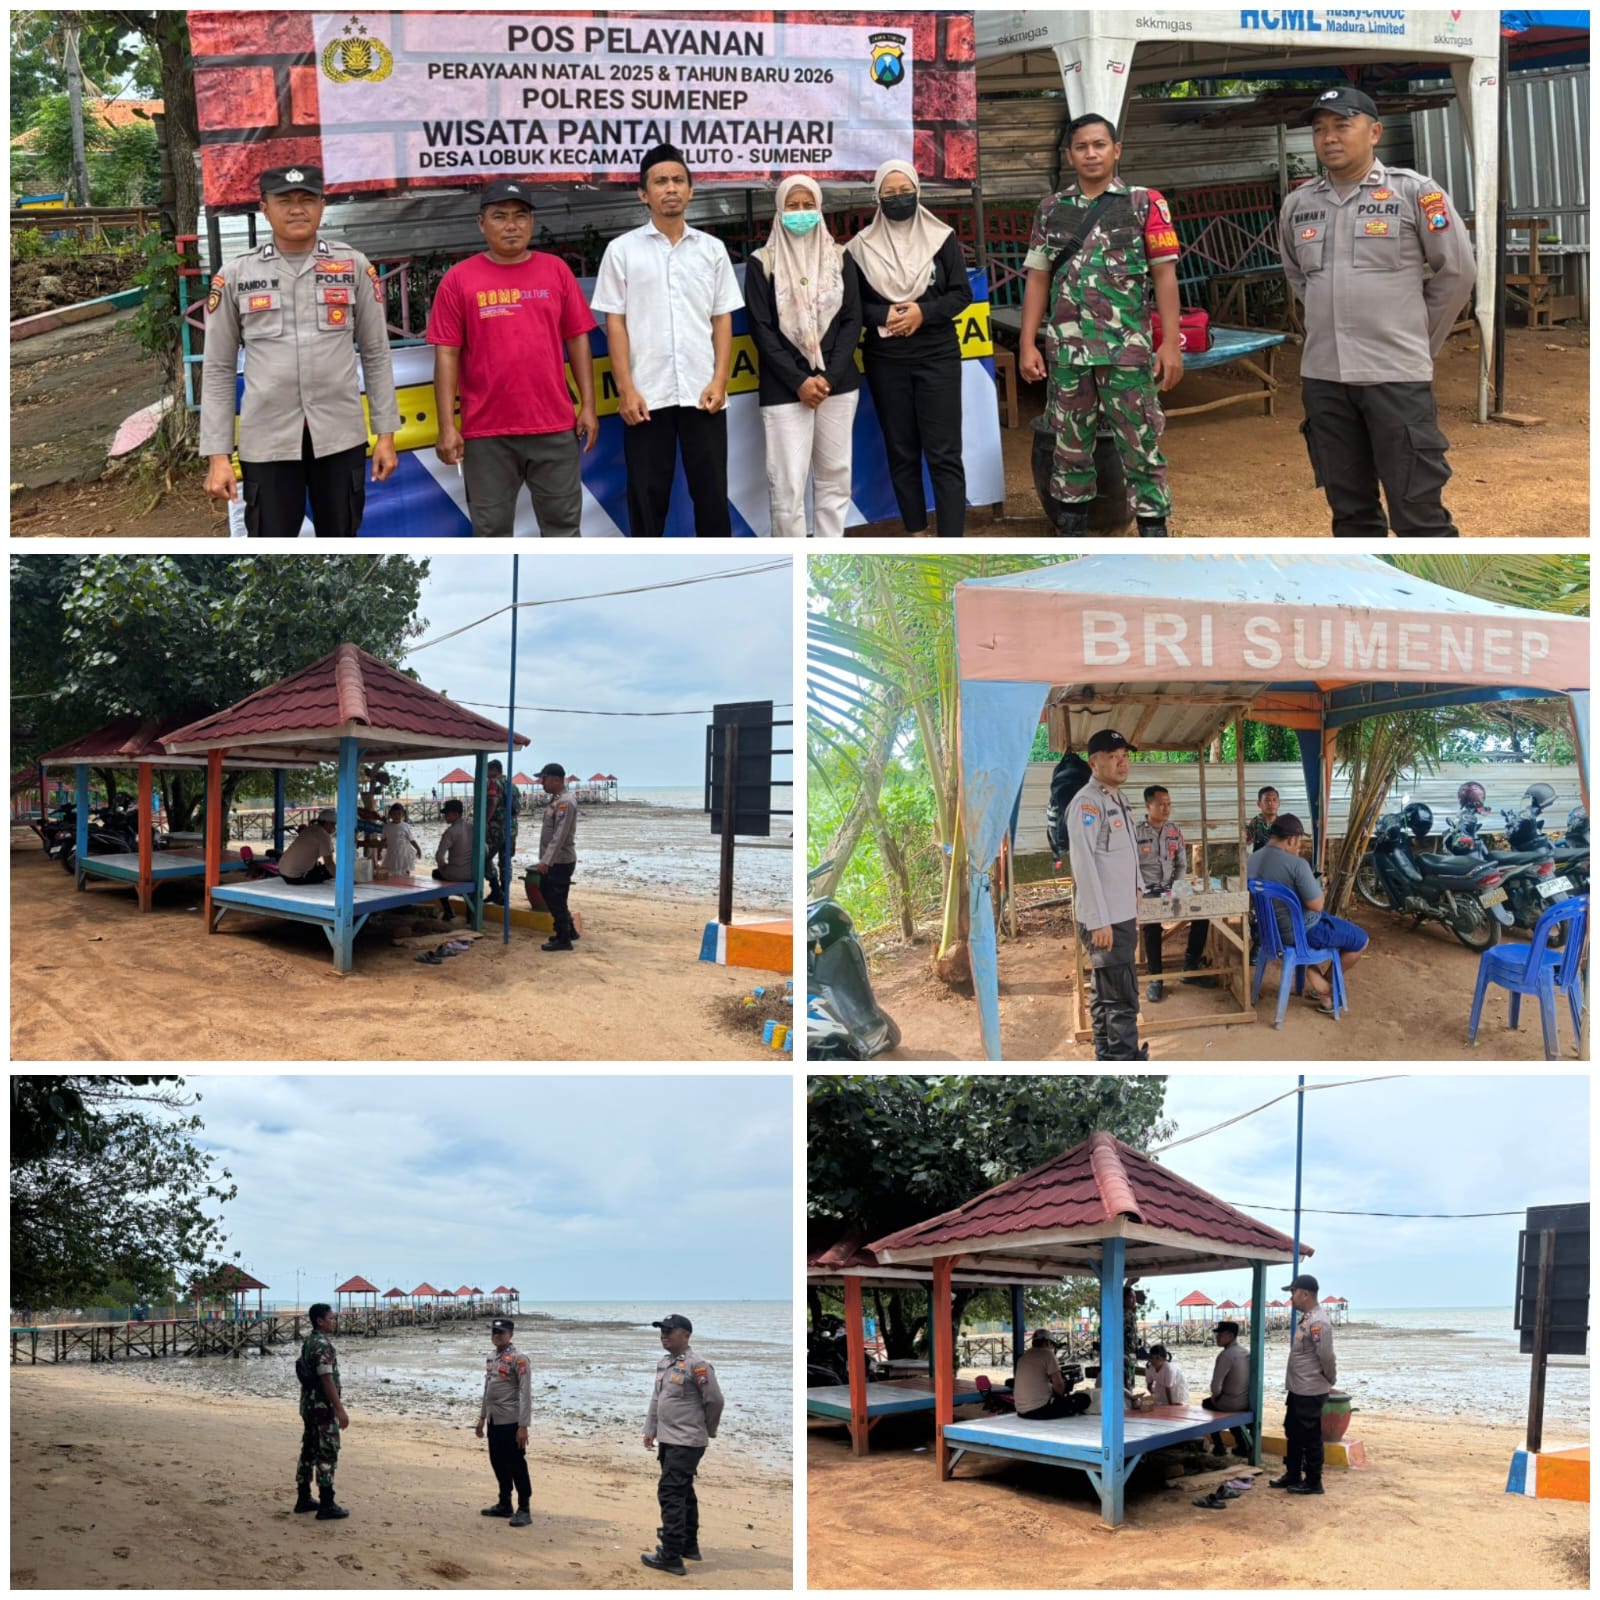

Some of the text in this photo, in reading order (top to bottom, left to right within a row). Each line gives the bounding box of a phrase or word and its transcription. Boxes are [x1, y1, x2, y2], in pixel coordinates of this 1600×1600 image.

[1136, 17, 1192, 32] skkmigas
[1326, 20, 1405, 35] Madura Limited
[507, 25, 764, 56] POS PELAYANAN
[998, 26, 1048, 46] skkmigas
[1433, 35, 1473, 46] skkmigas
[428, 63, 834, 84] PERAYAAN NATAL 2025 & TAHUN BARU 2026
[522, 88, 748, 111] POLRES SUMENEP
[422, 120, 834, 147] WISATA PANTAI MATAHARI
[419, 151, 474, 168] DESA
[479, 149, 544, 166] LOBUK
[749, 149, 832, 164] SUMENEP
[1320, 210, 1326, 219] H
[1357, 205, 1399, 215] POLRI
[271, 279, 279, 289] W
[316, 274, 355, 284] POLRI
[1082, 610, 1550, 675] BRI SUMENEP
